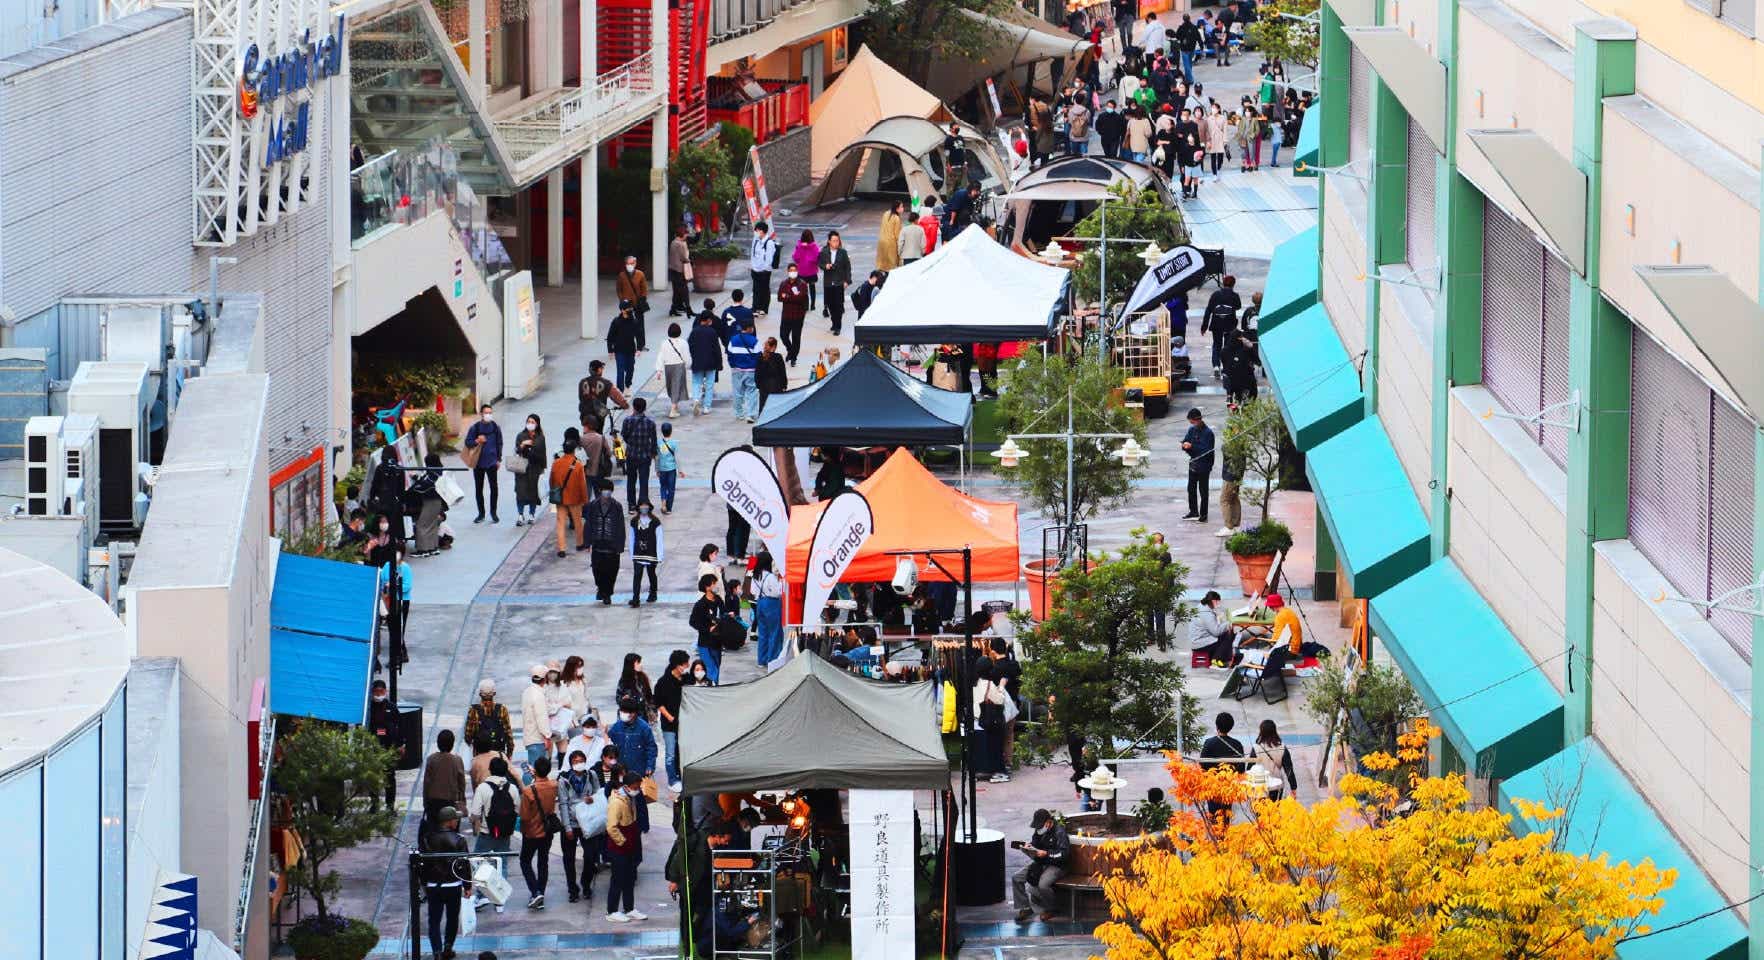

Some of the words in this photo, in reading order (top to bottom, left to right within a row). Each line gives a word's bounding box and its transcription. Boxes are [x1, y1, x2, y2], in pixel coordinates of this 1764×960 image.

[243, 13, 344, 105] Carnival
[266, 100, 308, 168] Mall
[823, 522, 865, 578] Orange
[873, 812, 889, 935] 野良道具製作所
